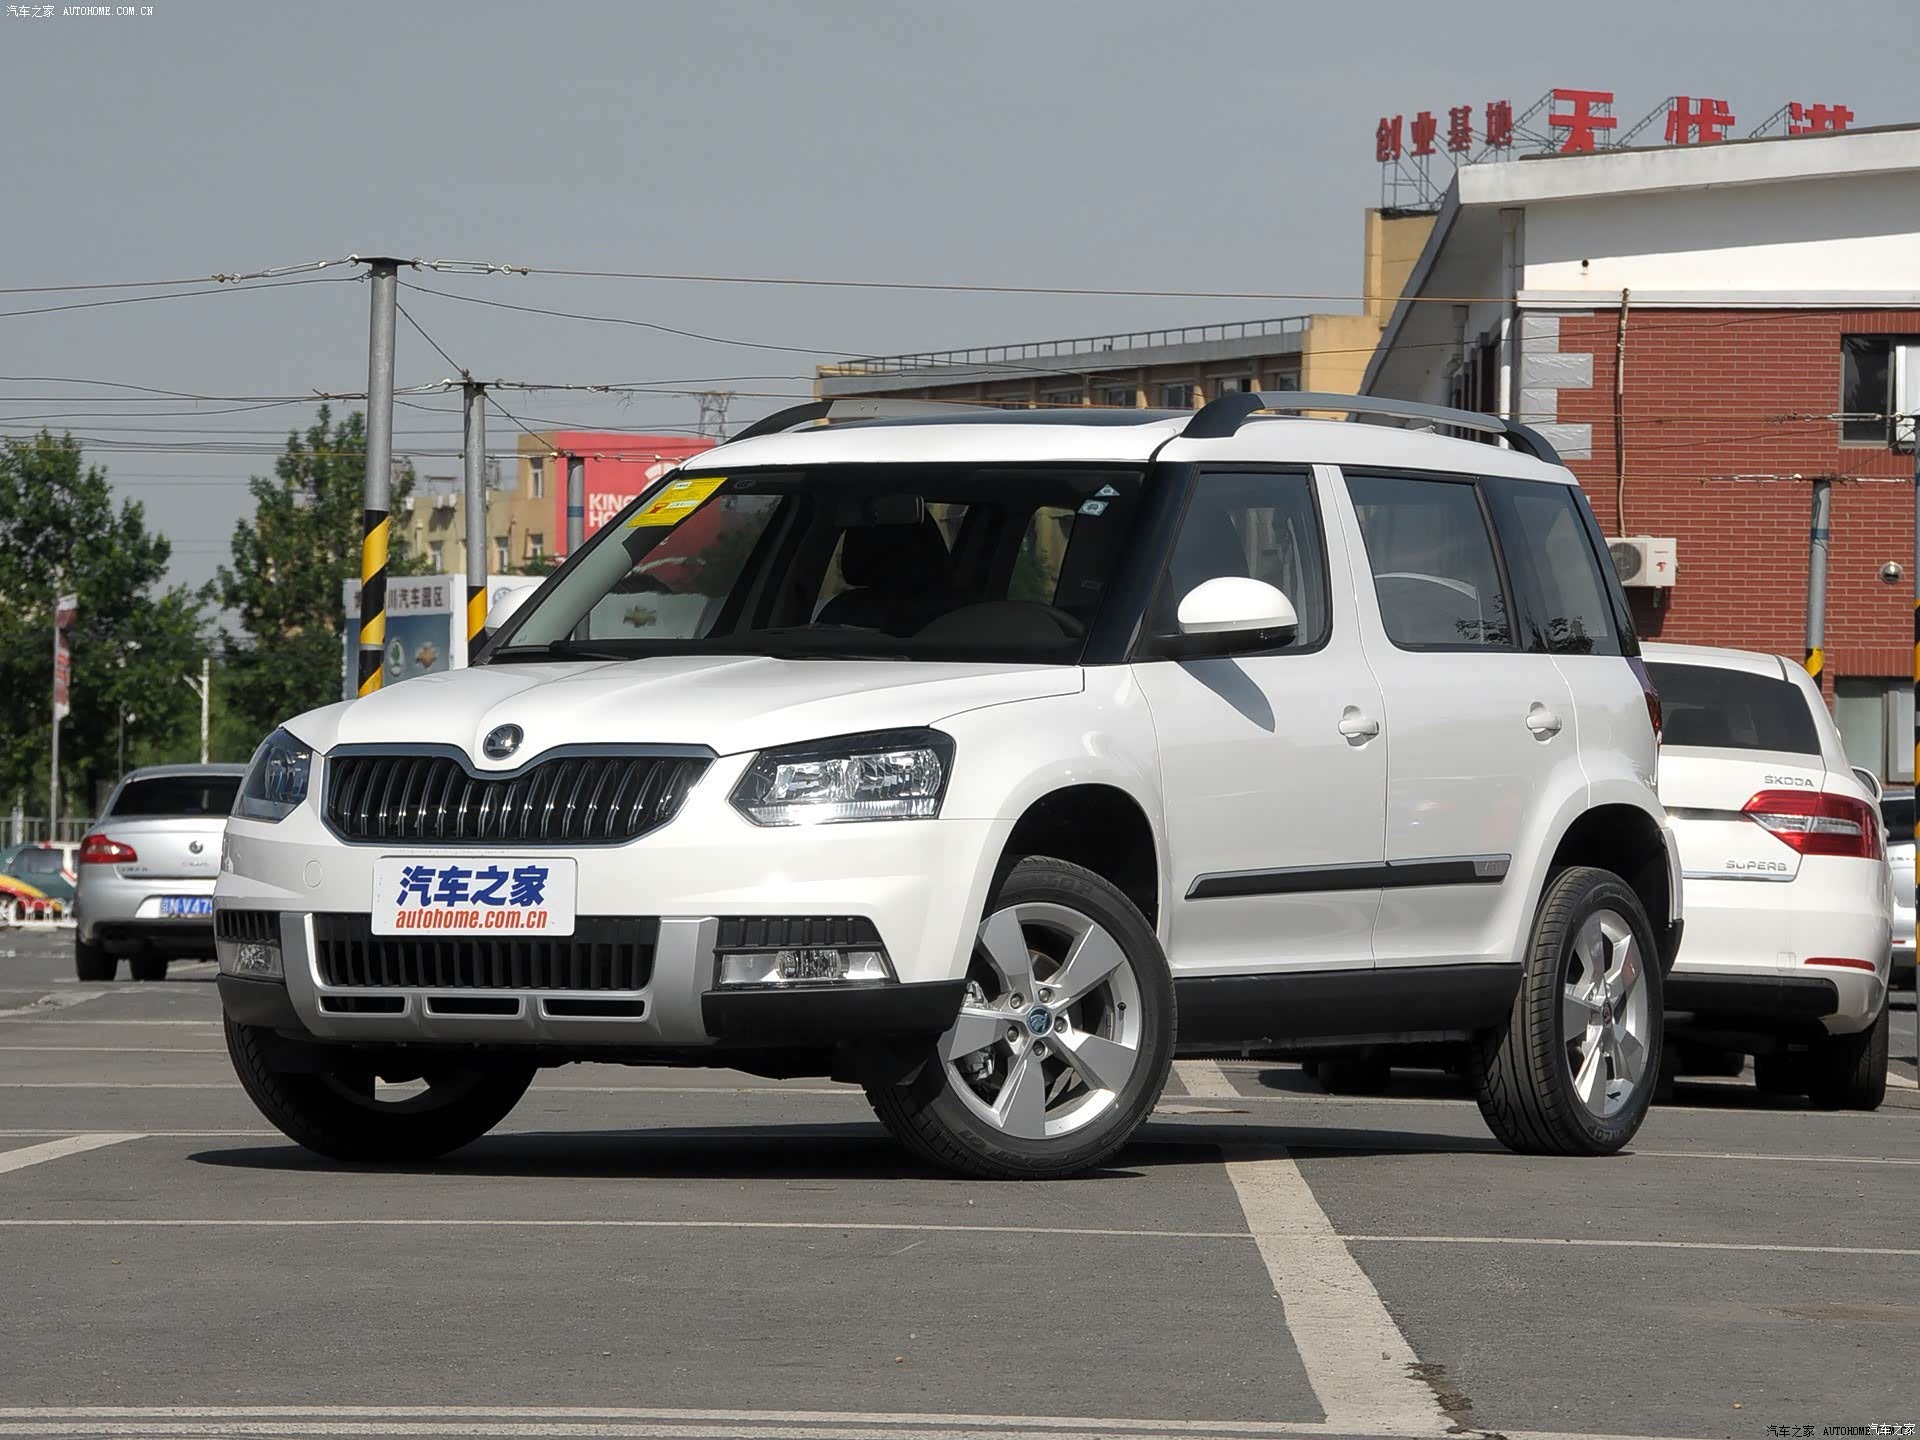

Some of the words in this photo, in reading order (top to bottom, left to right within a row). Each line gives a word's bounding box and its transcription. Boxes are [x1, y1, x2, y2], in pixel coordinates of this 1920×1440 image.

[1376, 100, 1512, 162] 创业基地
[1763, 775, 1814, 787] SKODA
[1726, 860, 1788, 871] SUPERB
[396, 864, 549, 907] 汽车之家
[395, 908, 548, 929] autohome.com.cn
